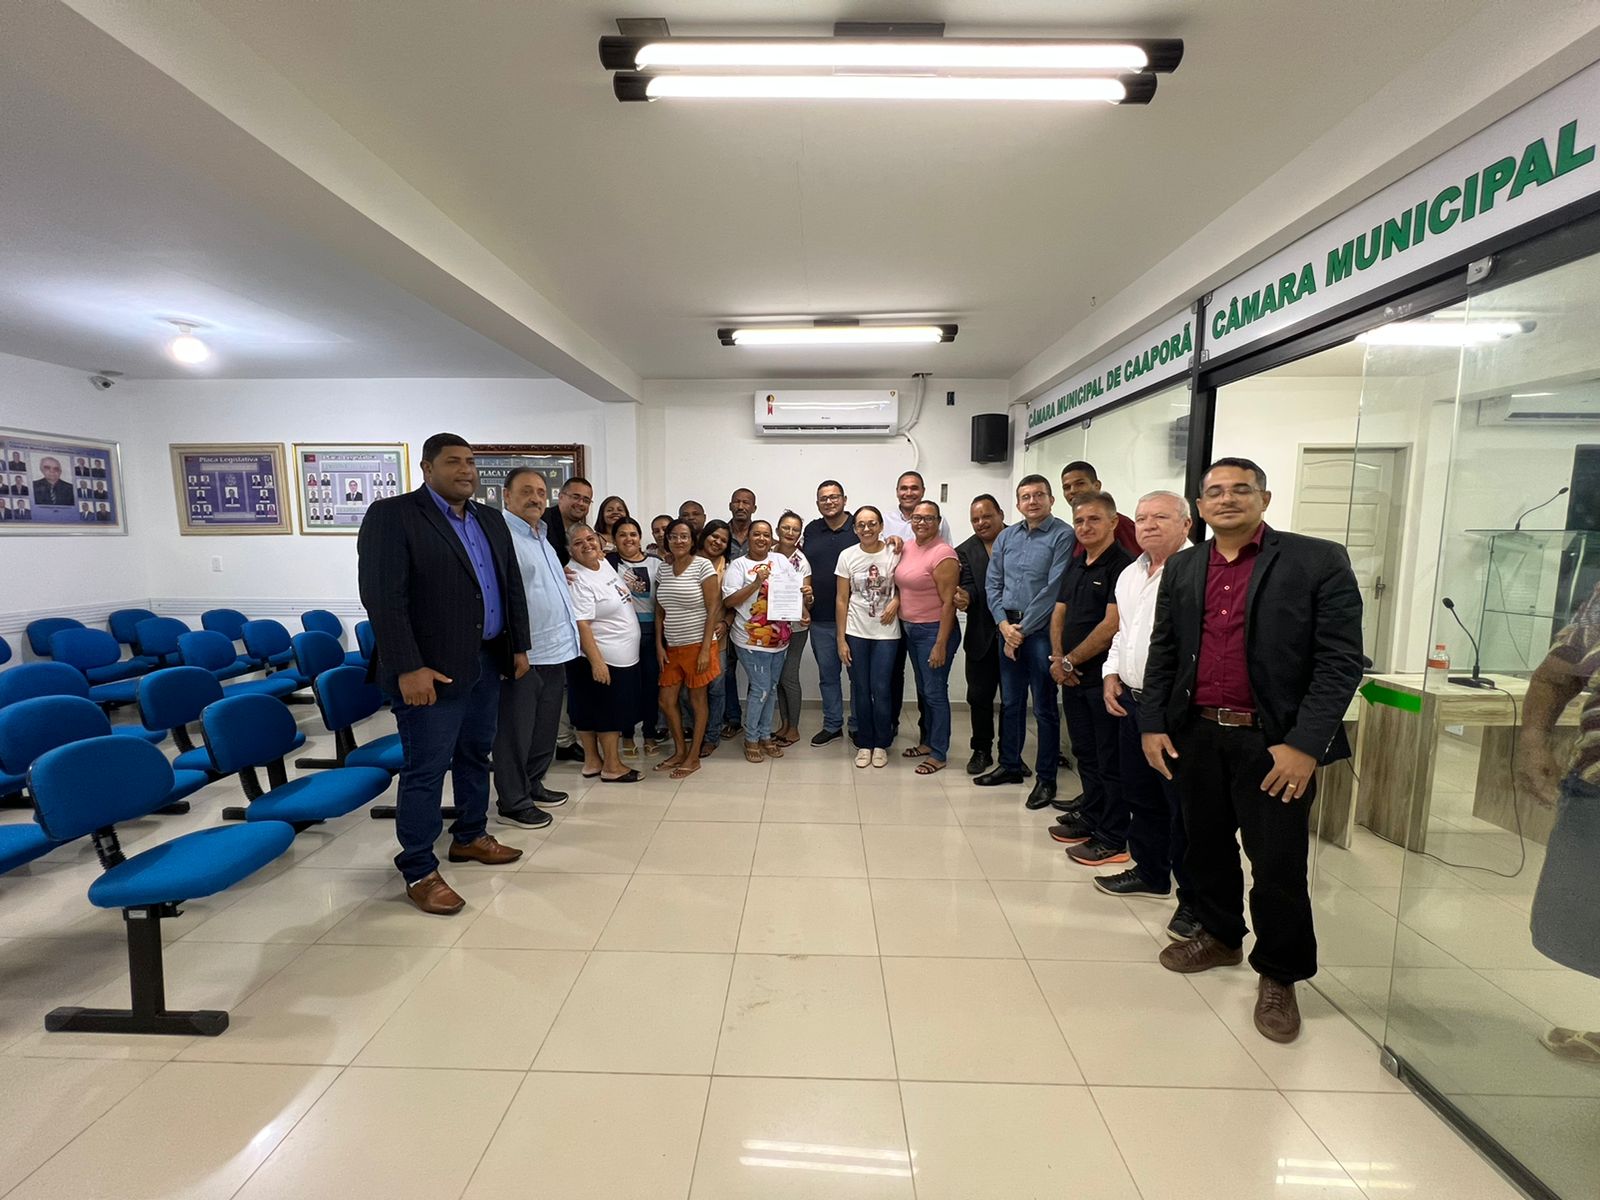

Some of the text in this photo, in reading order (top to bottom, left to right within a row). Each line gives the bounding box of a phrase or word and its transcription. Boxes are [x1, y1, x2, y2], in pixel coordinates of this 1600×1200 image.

[1212, 119, 1596, 340] CÂMARA MUNICIPAL
[1028, 402, 1055, 428] CÂMARA
[1057, 376, 1104, 416] MUNICIPAL
[1106, 365, 1122, 392] DE
[220, 456, 258, 464] Legislativa
